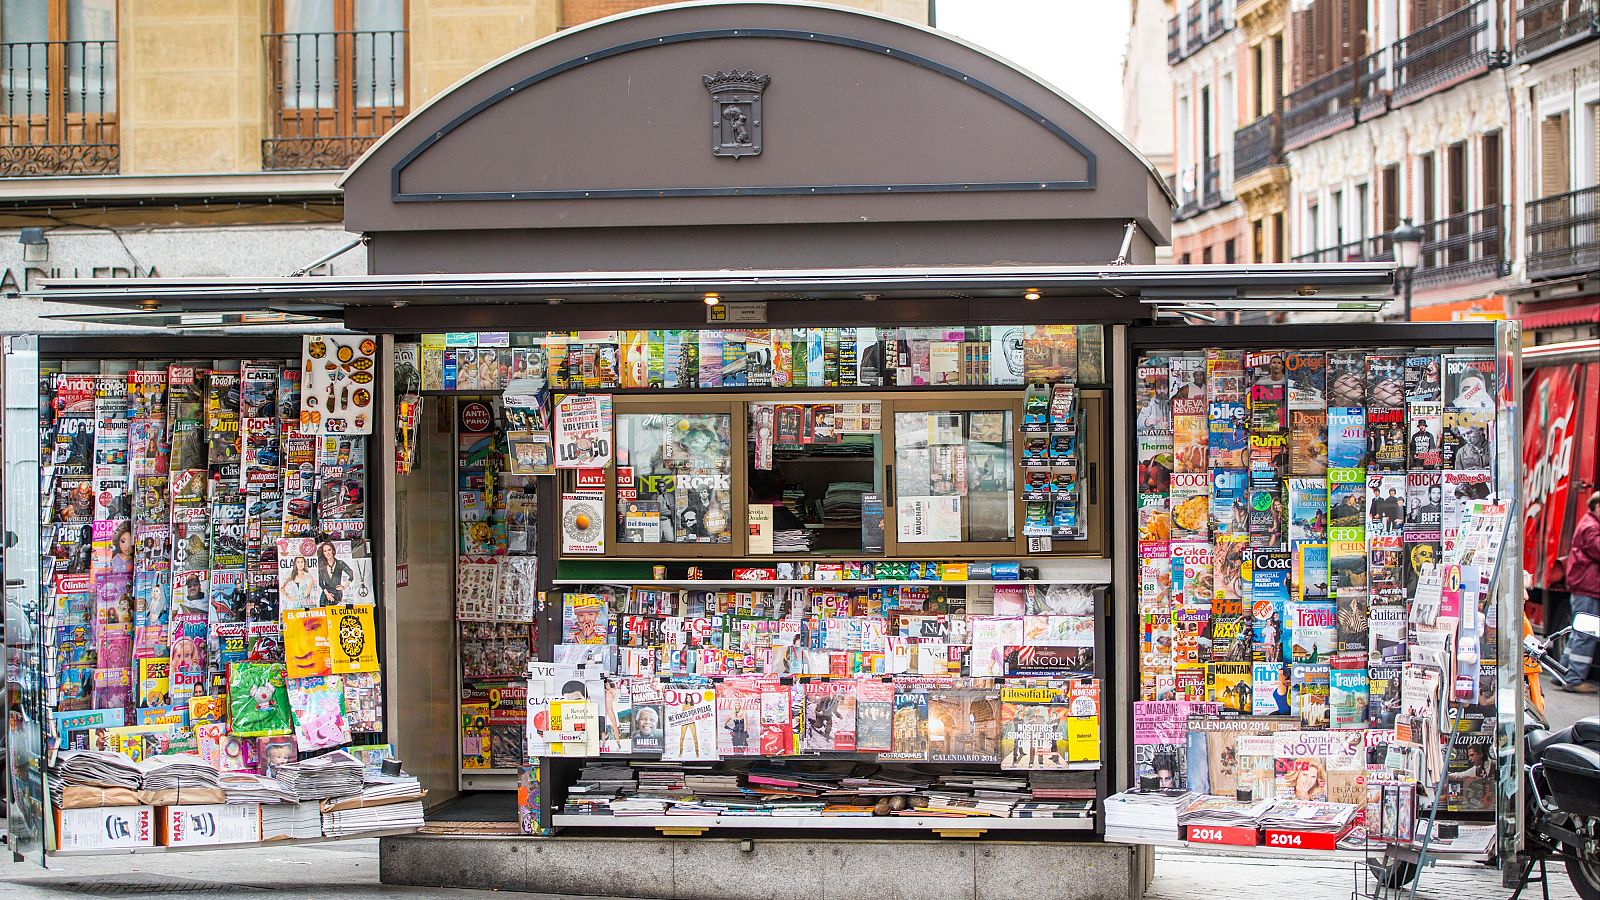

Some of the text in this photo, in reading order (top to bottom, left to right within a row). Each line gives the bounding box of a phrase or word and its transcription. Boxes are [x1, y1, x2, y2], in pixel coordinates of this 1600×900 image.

[172, 367, 195, 378] caza
[171, 377, 194, 385] mayor
[1174, 406, 1205, 414] REVISTA
[1210, 403, 1246, 419] bike
[562, 421, 599, 432] VOLVERTE
[1141, 442, 1173, 451] Thermo
[1329, 471, 1357, 483] GEO
[261, 491, 281, 500] BMW
[94, 521, 112, 530] TOP
[323, 521, 364, 530] SOLO MOTO
[638, 520, 659, 528] Bosque
[58, 526, 81, 543] Play
[1329, 530, 1357, 541] GEO
[1143, 583, 1155, 591] 68
[225, 639, 244, 650] 322
[1017, 656, 1077, 666] LINCOLN
[1002, 686, 1040, 698] Filosofía
[489, 688, 501, 710] 9
[675, 711, 689, 721] VENDO
[689, 708, 697, 717] POR
[697, 704, 712, 714] PIEZAS
[1017, 723, 1054, 732] NOSOTROS
[1188, 721, 1247, 731] CALENDARIO
[1249, 721, 1271, 731] 2014
[1007, 731, 1064, 740] SOMOS MEJORES
[637, 738, 659, 746] MANDELA
[1283, 743, 1357, 756] NOVELAS
[878, 752, 923, 760] NOSTRADAMUS
[932, 754, 998, 762] CALENDARIO 2014
[1192, 828, 1223, 841] 2014
[1270, 834, 1302, 846] 2014
